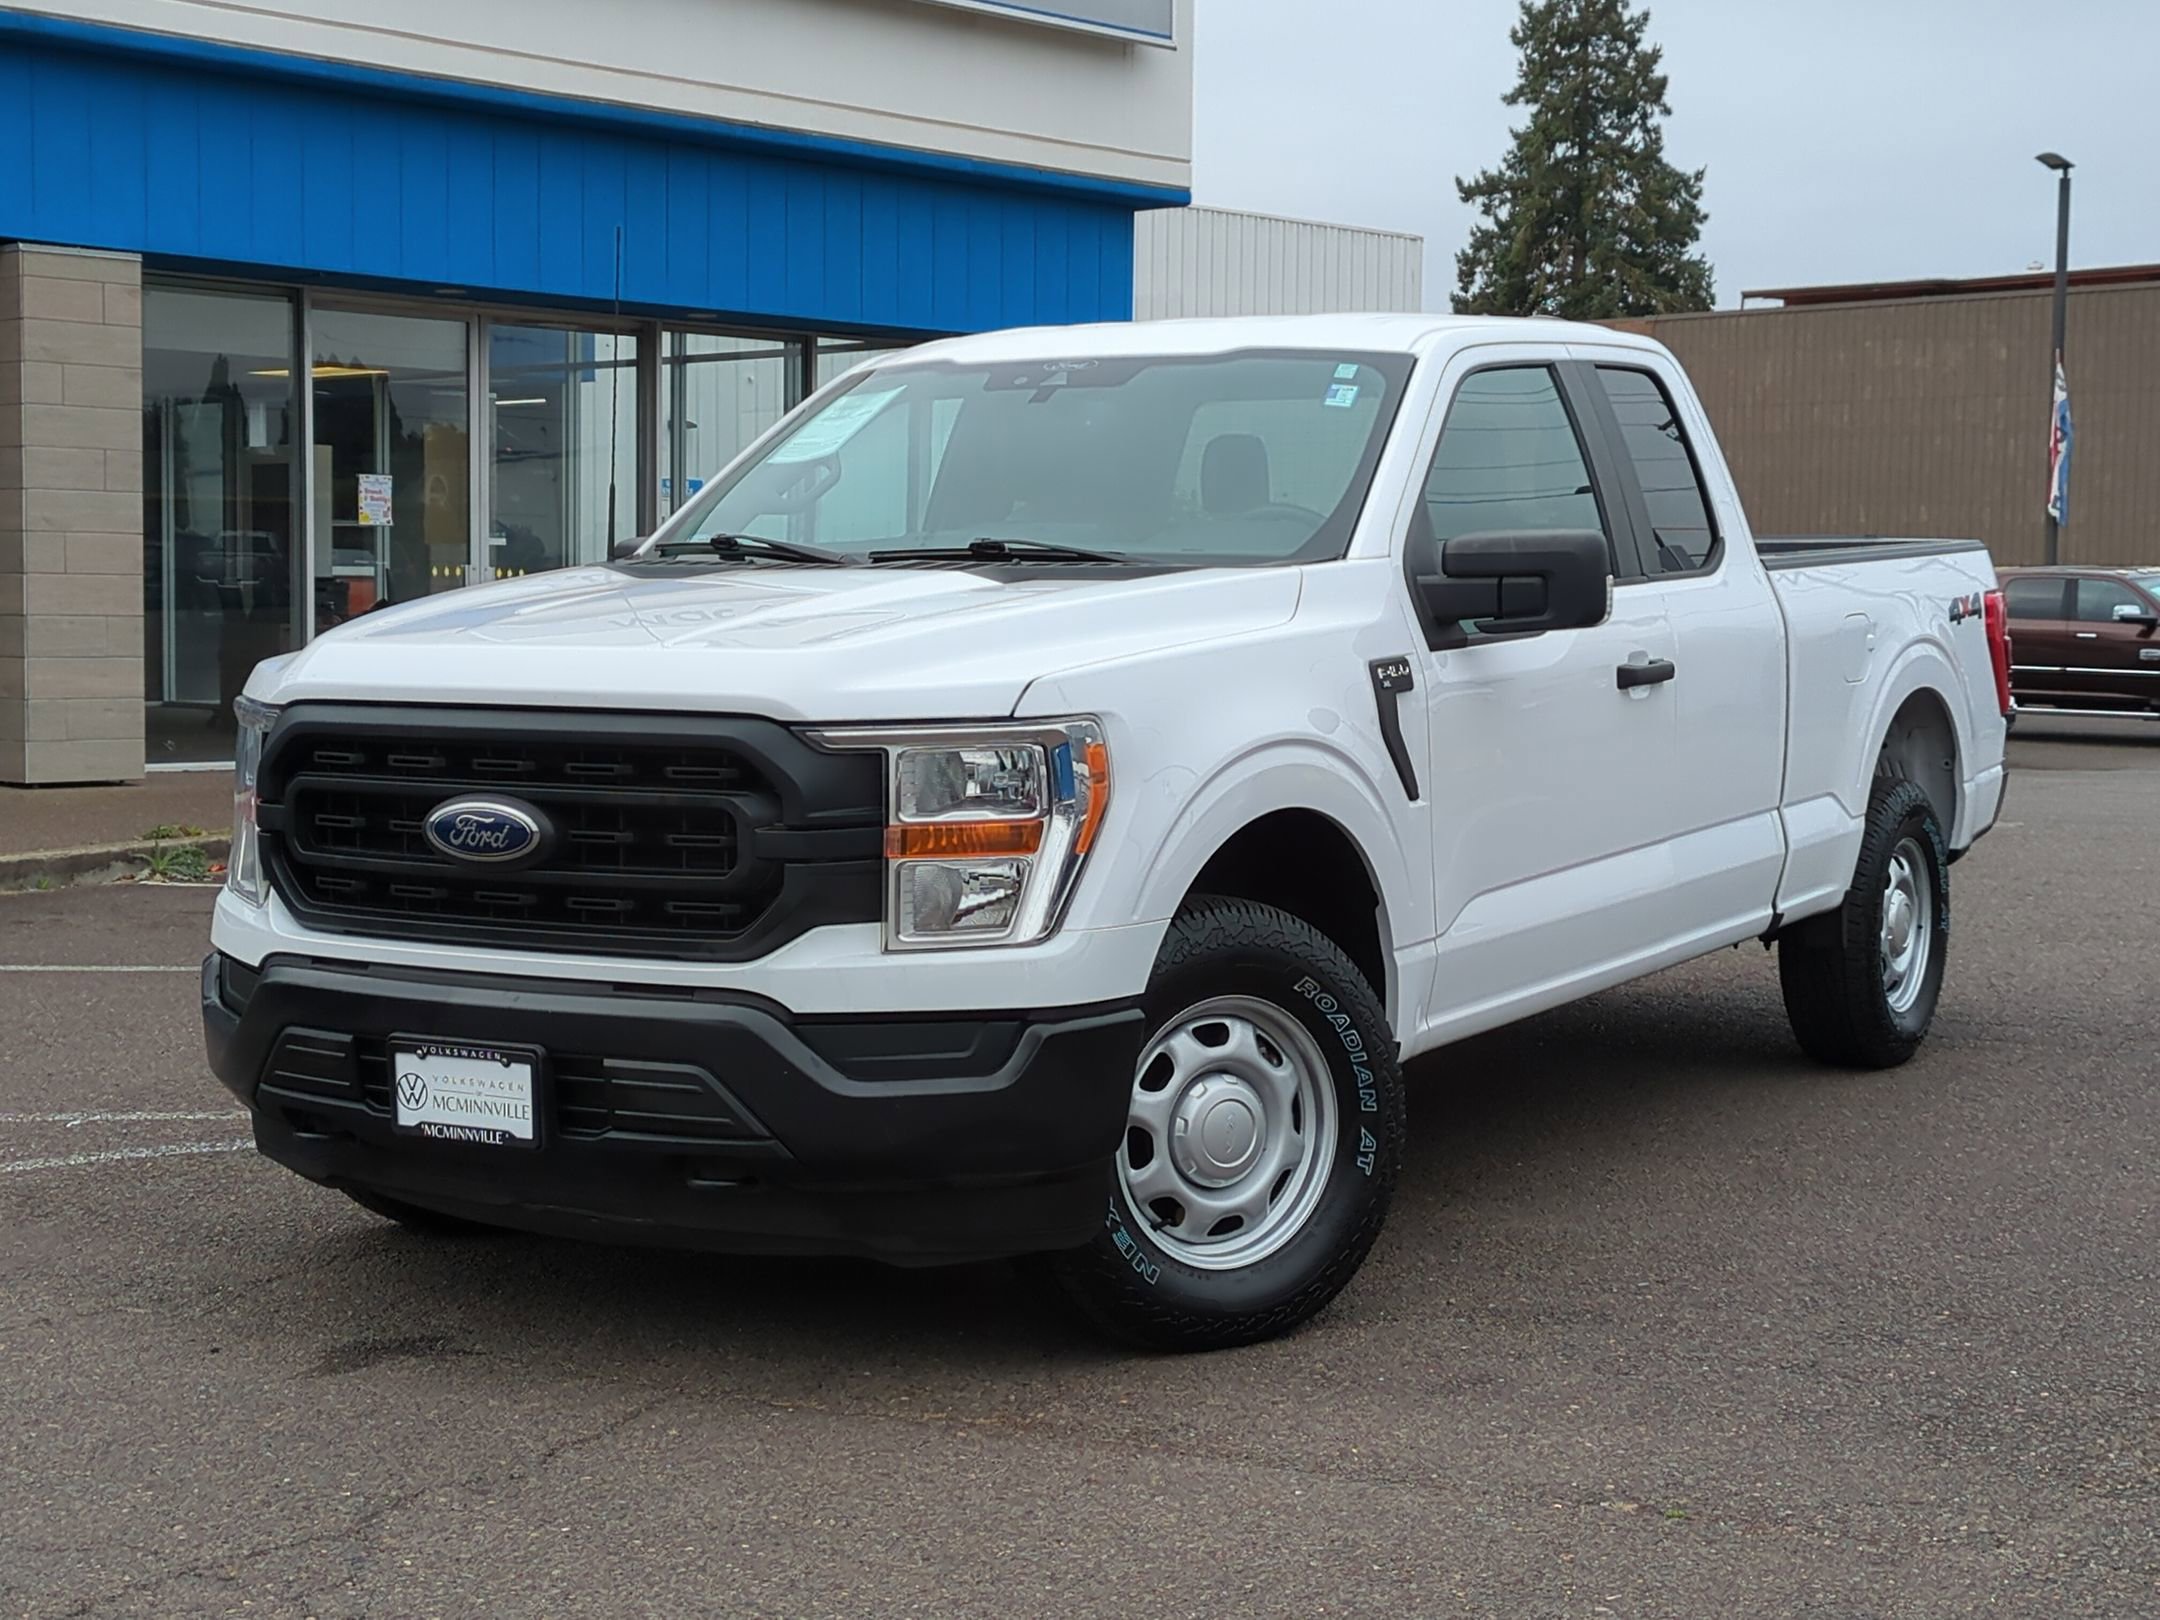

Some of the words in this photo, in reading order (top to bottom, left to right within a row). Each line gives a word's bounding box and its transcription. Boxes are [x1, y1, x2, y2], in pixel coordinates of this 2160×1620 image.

[449, 814, 510, 848] Ford
[421, 1045, 501, 1060] VOLKSWAGEN
[432, 1074, 525, 1092] VOLKSWAGEN
[1293, 976, 1378, 1111] ROADIAN
[1357, 1126, 1377, 1175] AT
[432, 1095, 530, 1120] MCMINNVILLE
[423, 1123, 503, 1145] MCMINNVILLE
